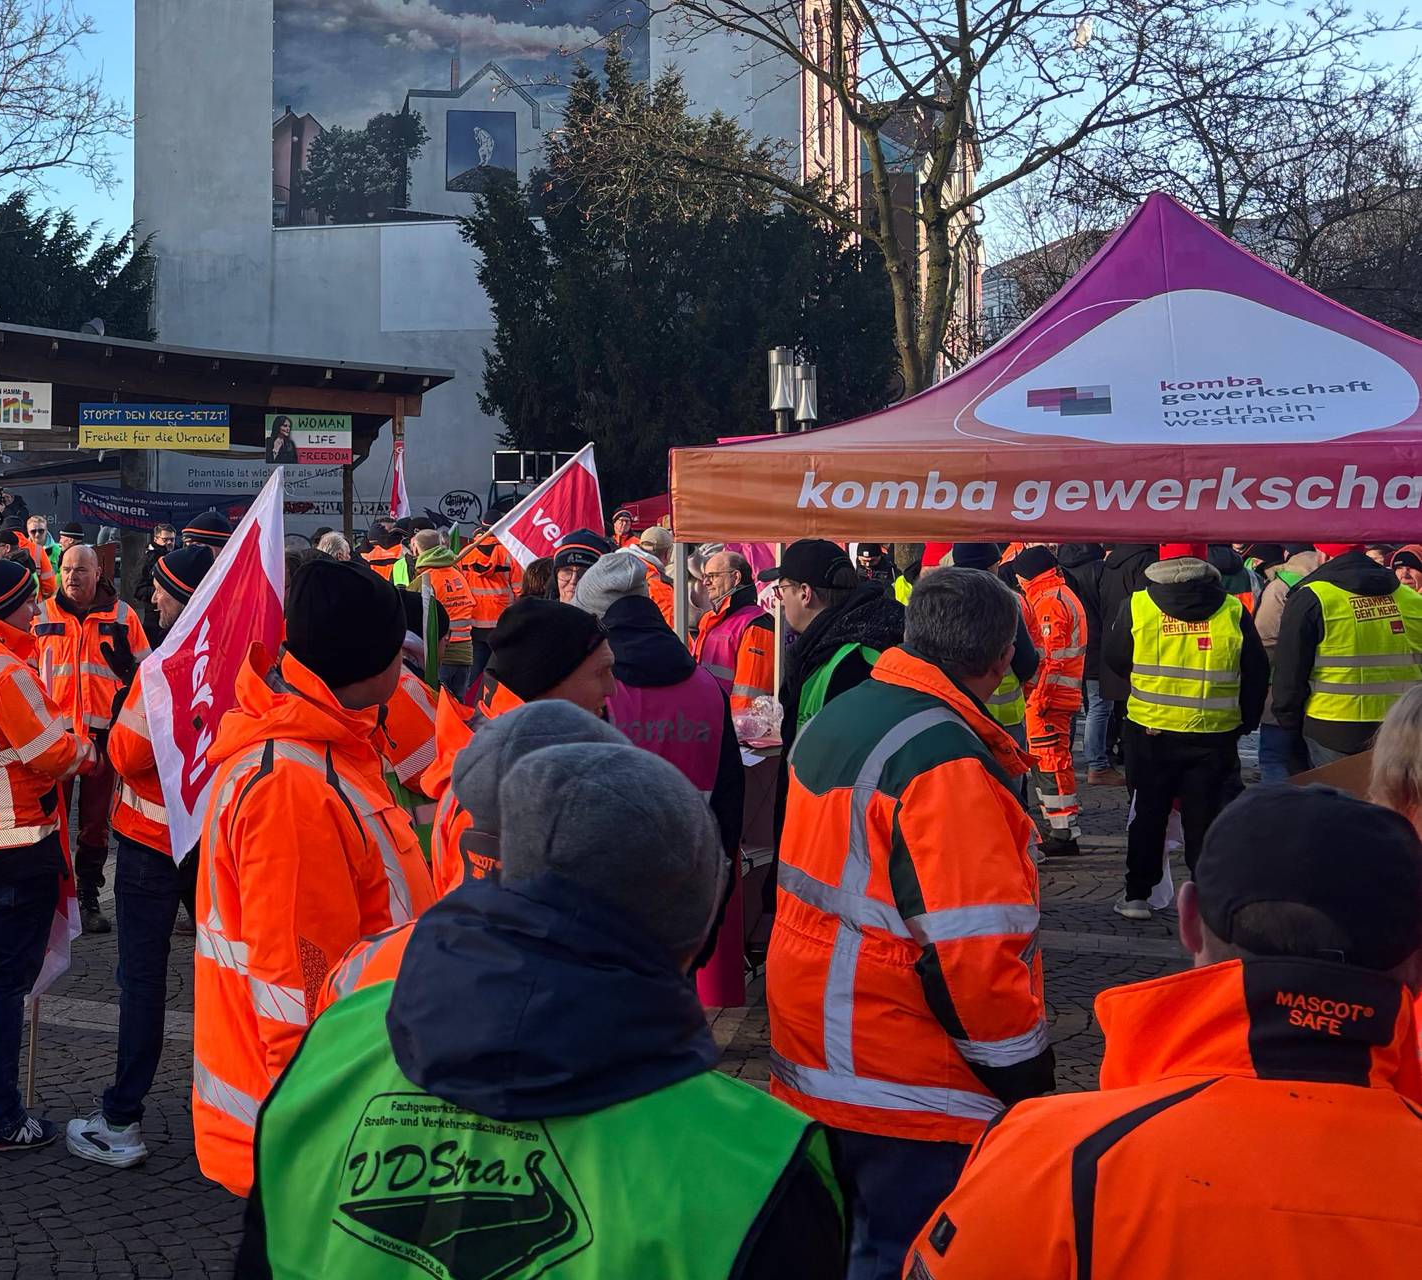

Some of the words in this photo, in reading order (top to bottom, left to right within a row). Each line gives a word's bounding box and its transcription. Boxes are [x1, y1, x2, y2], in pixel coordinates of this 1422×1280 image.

[1160, 376, 1263, 391] komba
[1161, 381, 1374, 405] gewerkschaft
[83, 409, 122, 420] STOPPT
[125, 410, 145, 420] DEN
[1163, 403, 1326, 418] nordrhein-
[298, 417, 345, 429] WOMAN
[1164, 414, 1316, 427] westfalen
[85, 430, 128, 443] Freiheit
[133, 430, 150, 444] für
[155, 432, 173, 443] die
[176, 432, 226, 443] Ukraine!
[308, 434, 337, 444] LIFE
[299, 451, 349, 461] FREEDOM
[188, 468, 234, 478] Phantasie
[237, 468, 249, 477] ist
[297, 468, 312, 477] als
[188, 479, 211, 488] denn
[213, 479, 248, 488] Wissen
[251, 479, 263, 488] ist
[797, 471, 998, 510] komba
[79, 491, 149, 517] Zusammen.
[1355, 608, 1375, 620] GEHT
[1377, 605, 1401, 617] MEHR
[1163, 623, 1185, 633] GEHT
[1289, 1009, 1343, 1035] SAFE
[401, 1116, 419, 1127] und
